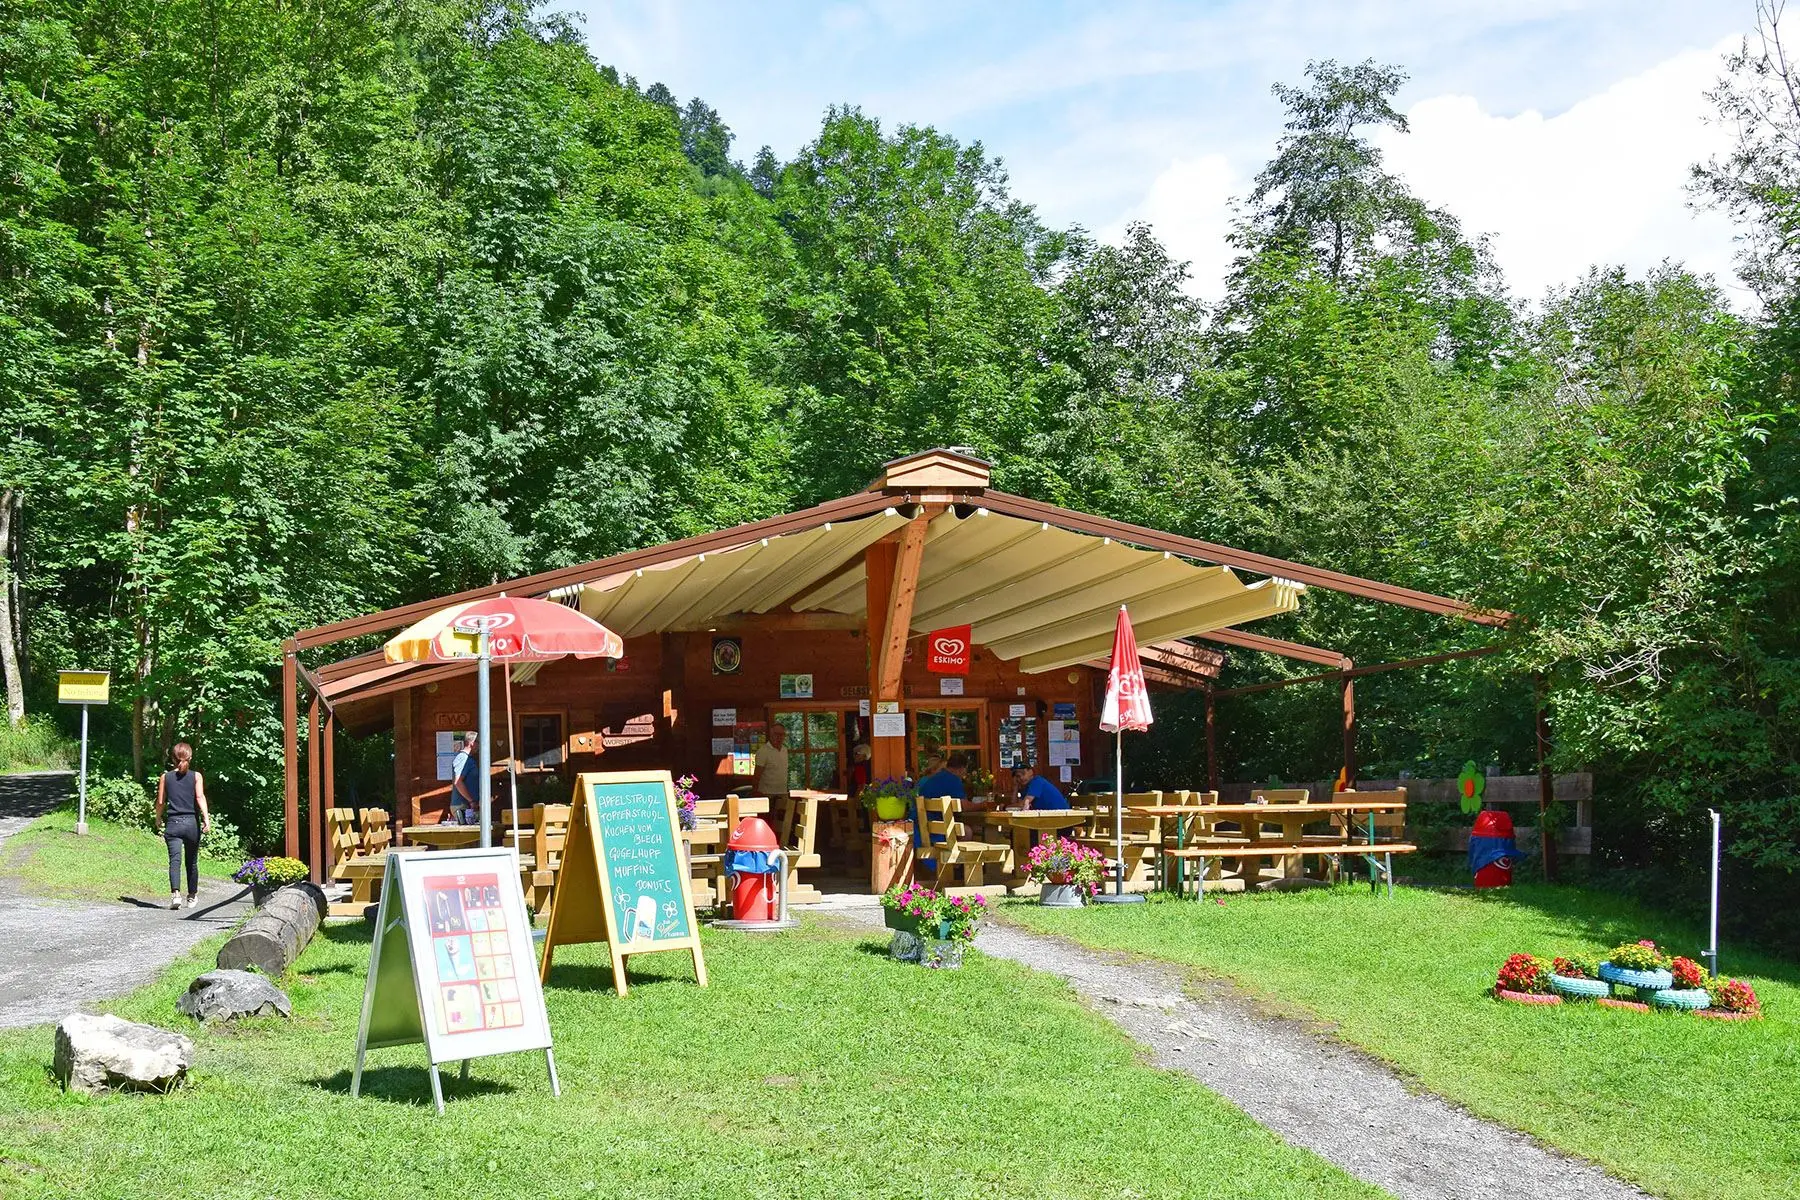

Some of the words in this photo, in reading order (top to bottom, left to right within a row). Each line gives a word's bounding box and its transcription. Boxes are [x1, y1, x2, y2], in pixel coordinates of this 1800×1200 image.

[933, 655, 964, 665] ESKIMO
[604, 825, 635, 838] KUCHEN
[633, 834, 663, 846] BLECH
[609, 846, 662, 861] GUGELHUPF
[614, 864, 656, 879] MUFFINS
[635, 879, 672, 893] DONUTS
